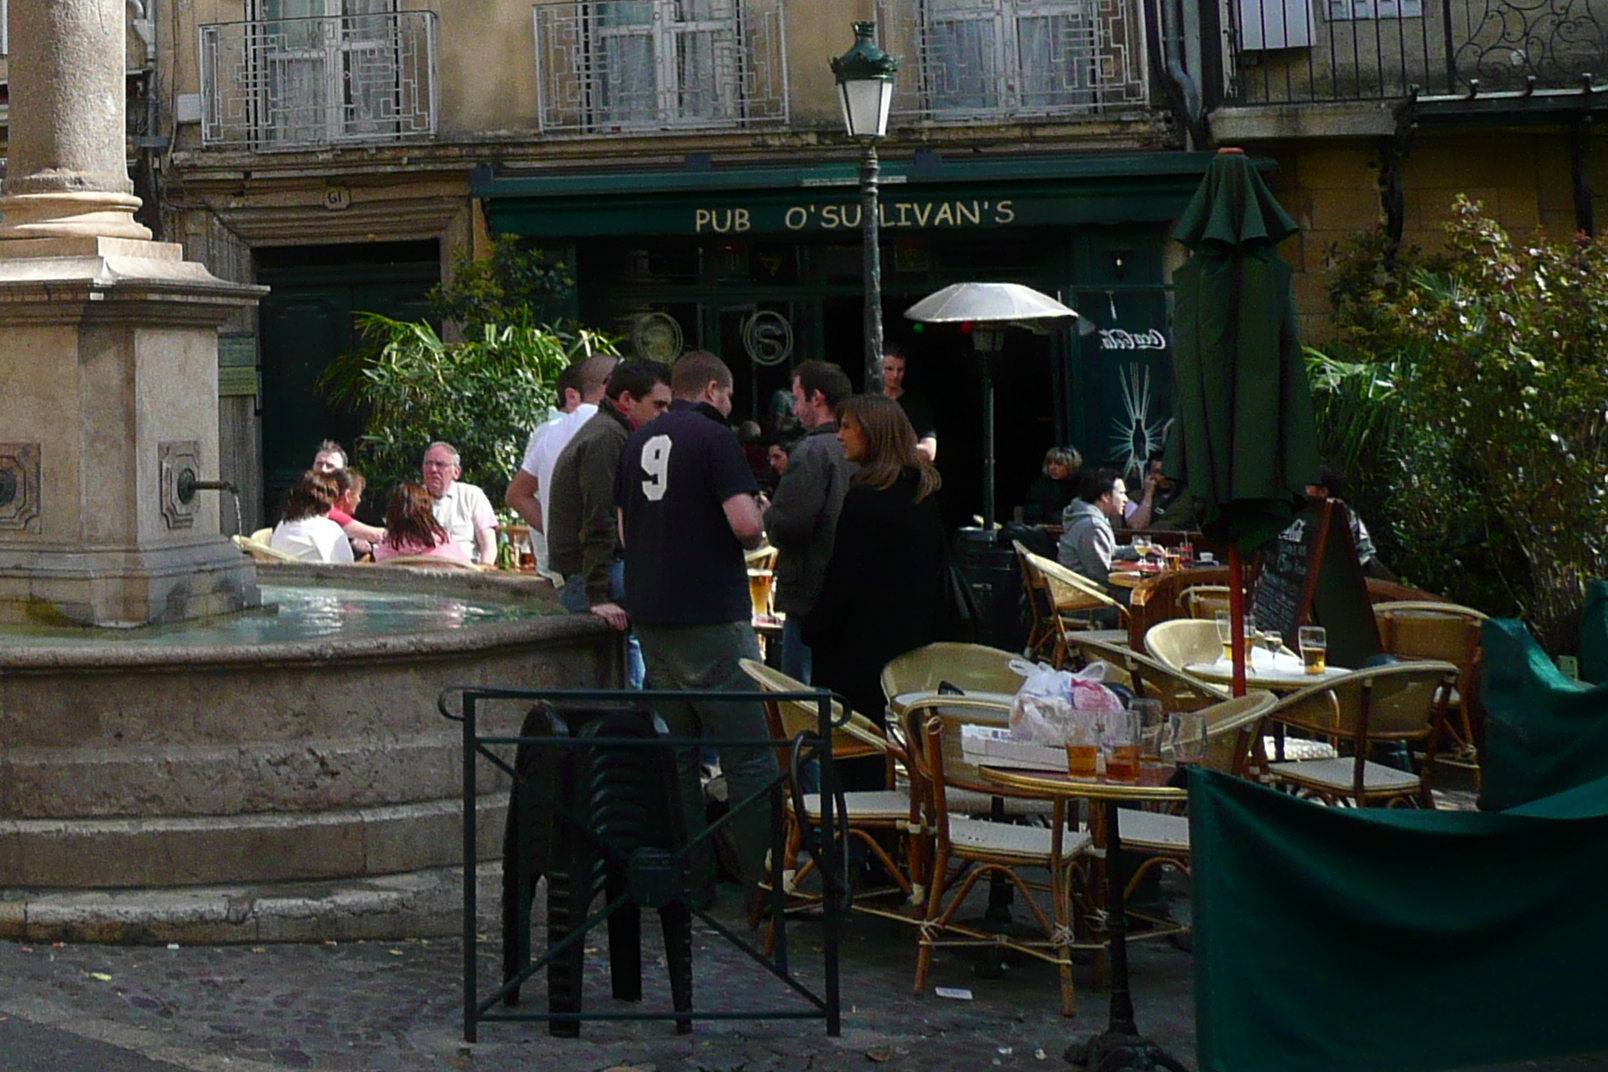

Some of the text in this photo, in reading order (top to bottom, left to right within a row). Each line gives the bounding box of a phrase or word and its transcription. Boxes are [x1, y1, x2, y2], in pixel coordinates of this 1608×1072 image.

[328, 191, 342, 204] 61
[695, 200, 1016, 232] PUB O'SULIVAN'S
[641, 434, 672, 501] 9
